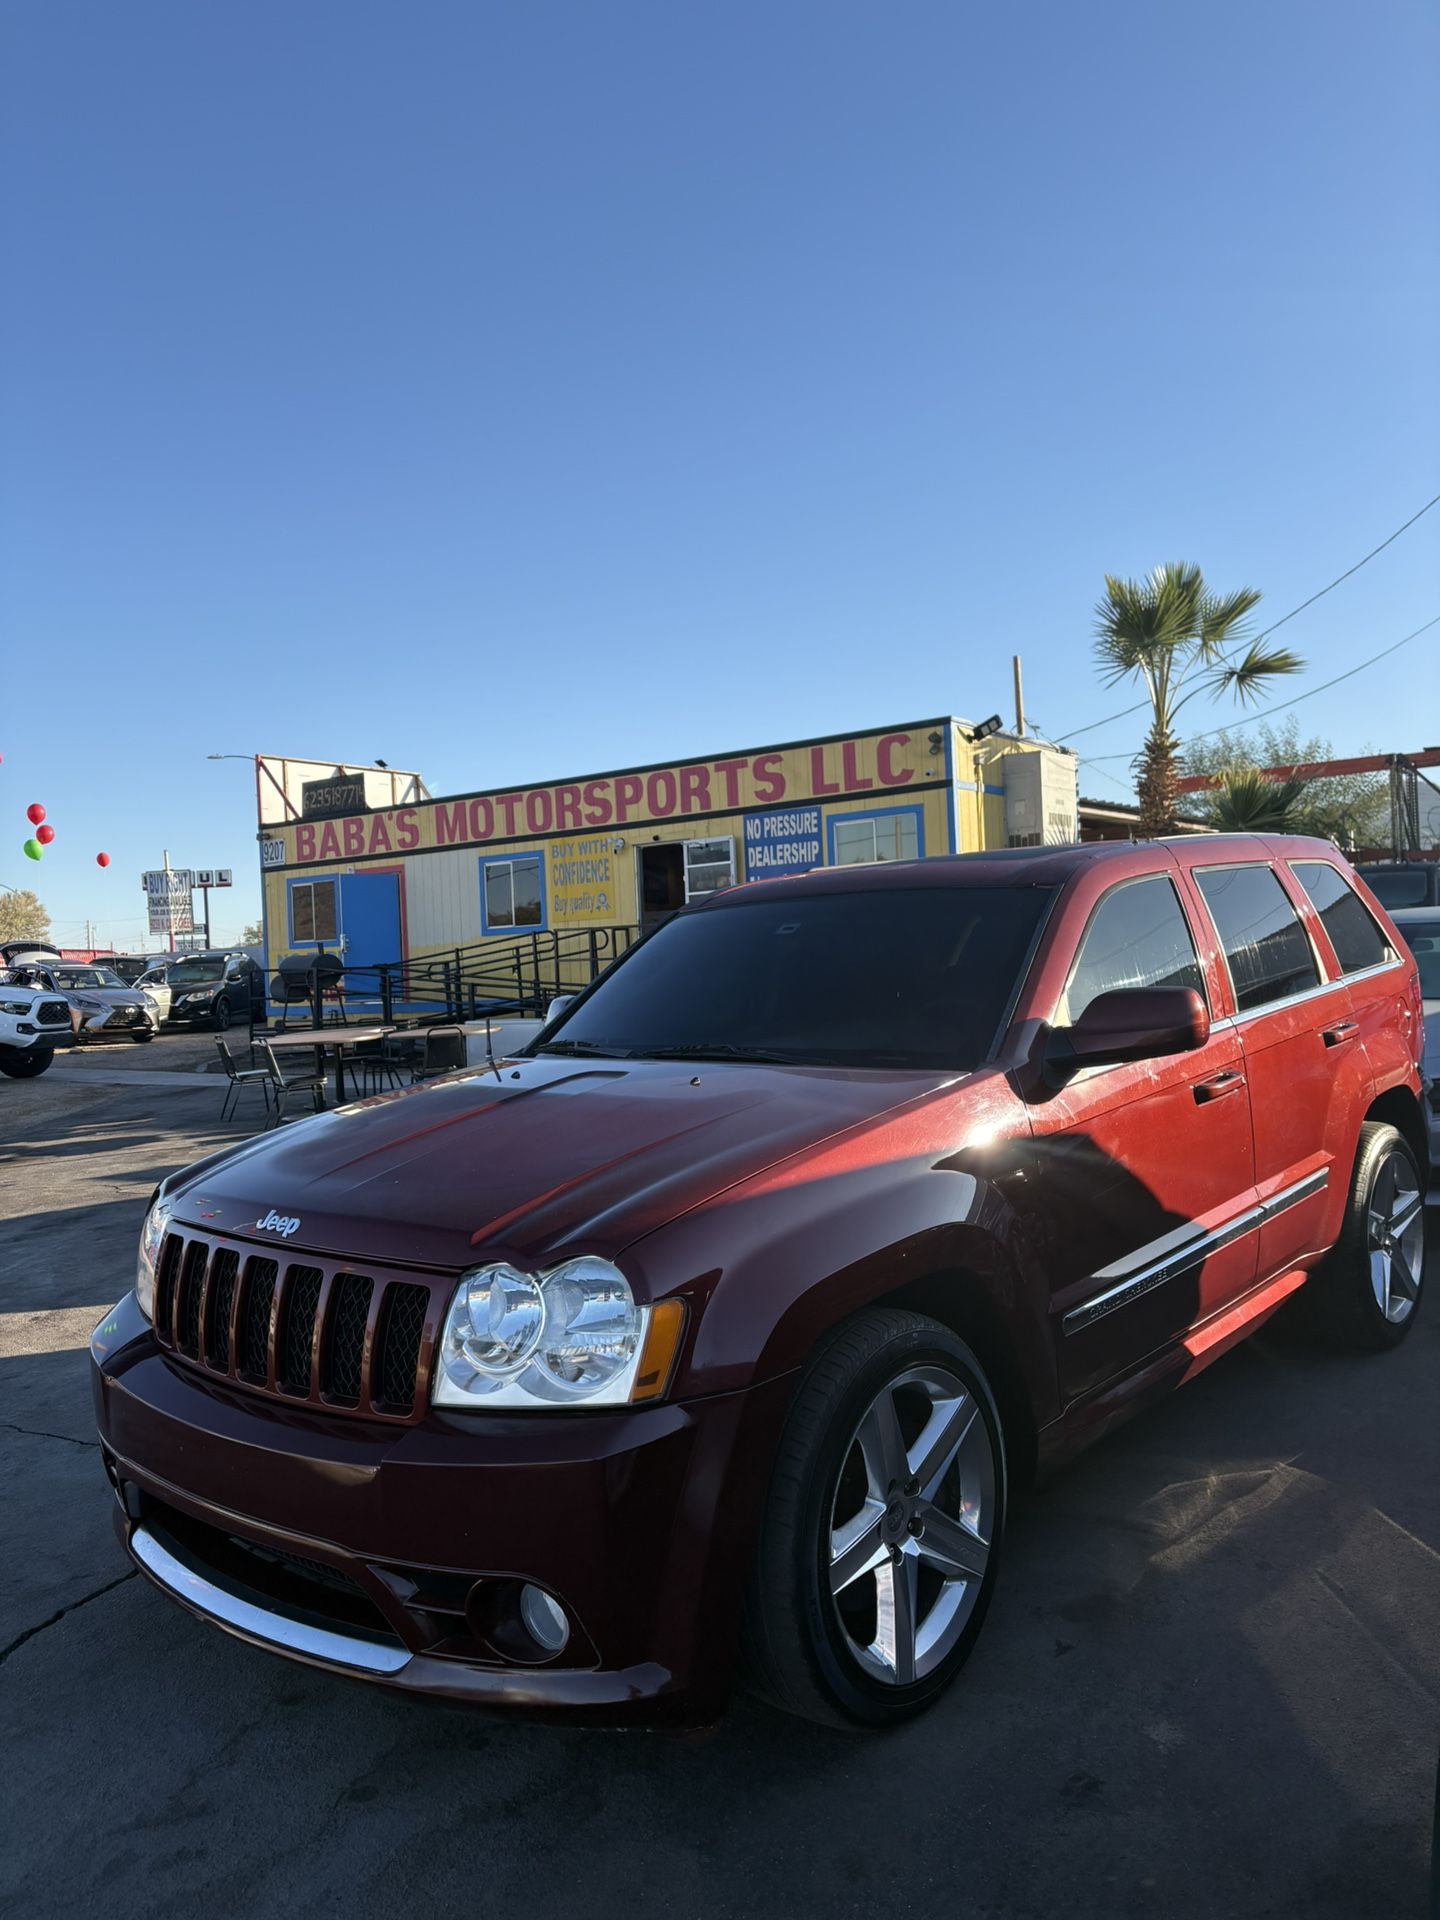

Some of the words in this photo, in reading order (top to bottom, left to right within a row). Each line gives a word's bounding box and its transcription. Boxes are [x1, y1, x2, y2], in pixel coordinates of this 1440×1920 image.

[295, 808, 419, 861] BABA'S
[435, 754, 786, 845] MOTORSPORTS
[810, 733, 915, 796] LLC
[746, 818, 761, 840] NO
[763, 812, 818, 838] PRESSURE
[264, 841, 284, 861] 9207
[552, 843, 574, 859] BUY
[577, 838, 608, 855] WITH
[748, 841, 819, 868] DEALERSHIP
[148, 873, 164, 894] BUY
[552, 858, 609, 887] CONFIDENCE
[554, 895, 568, 916] Buy
[569, 892, 595, 915] quality
[256, 1209, 301, 1238] Jeep
